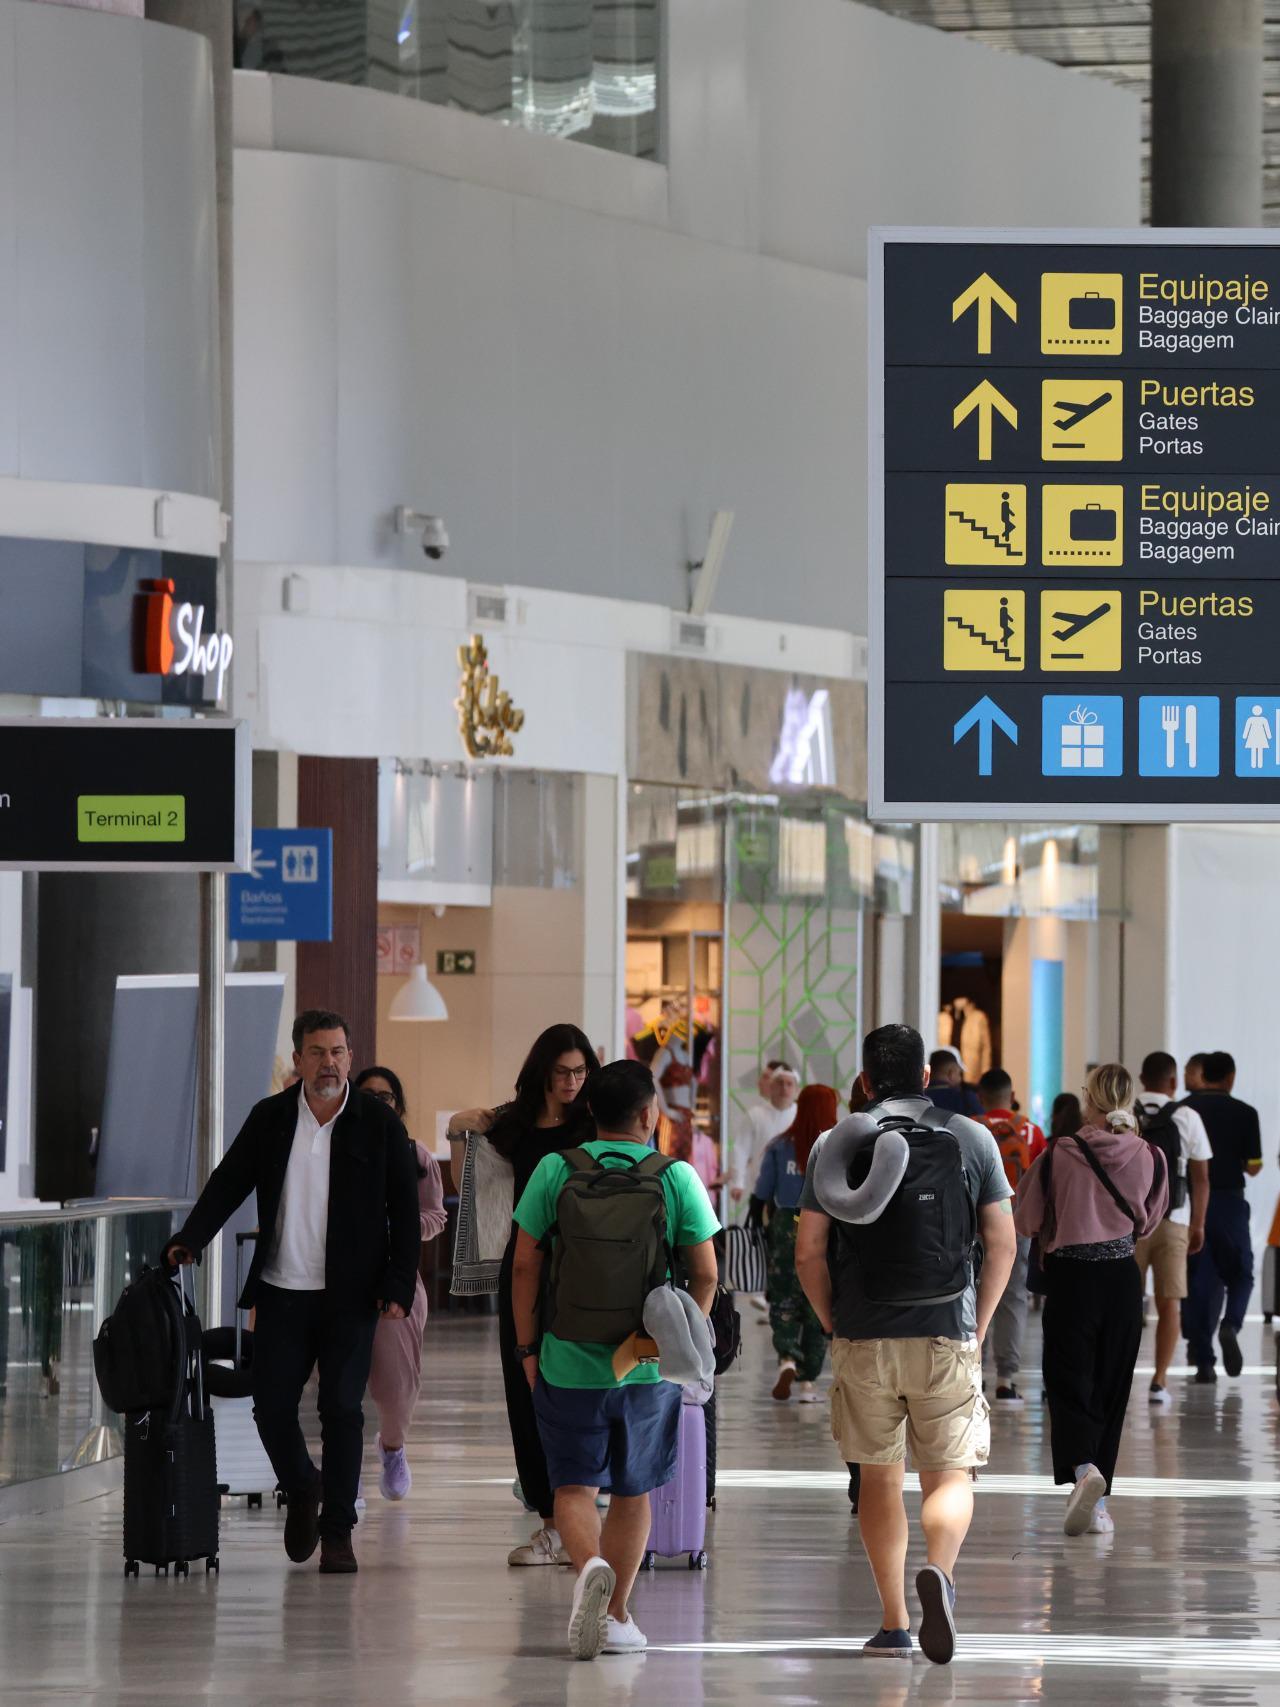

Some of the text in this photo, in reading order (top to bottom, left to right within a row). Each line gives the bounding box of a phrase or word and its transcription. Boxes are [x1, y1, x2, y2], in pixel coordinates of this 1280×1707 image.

[1139, 273, 1269, 309] Equipaje
[1139, 306, 1229, 329] Baggage
[1139, 330, 1234, 353] Bagagem
[1140, 379, 1255, 407] Puertas
[1139, 411, 1199, 432] Gates
[1139, 436, 1204, 456] Portas
[1140, 484, 1270, 519] Equipaje
[1139, 516, 1229, 540] Baggage
[1139, 541, 1235, 564] Bagagem
[1139, 590, 1253, 618] Puertas
[1137, 621, 1198, 642] Gates
[1138, 646, 1202, 666] Portas
[84, 811, 178, 827] Terminal 2
